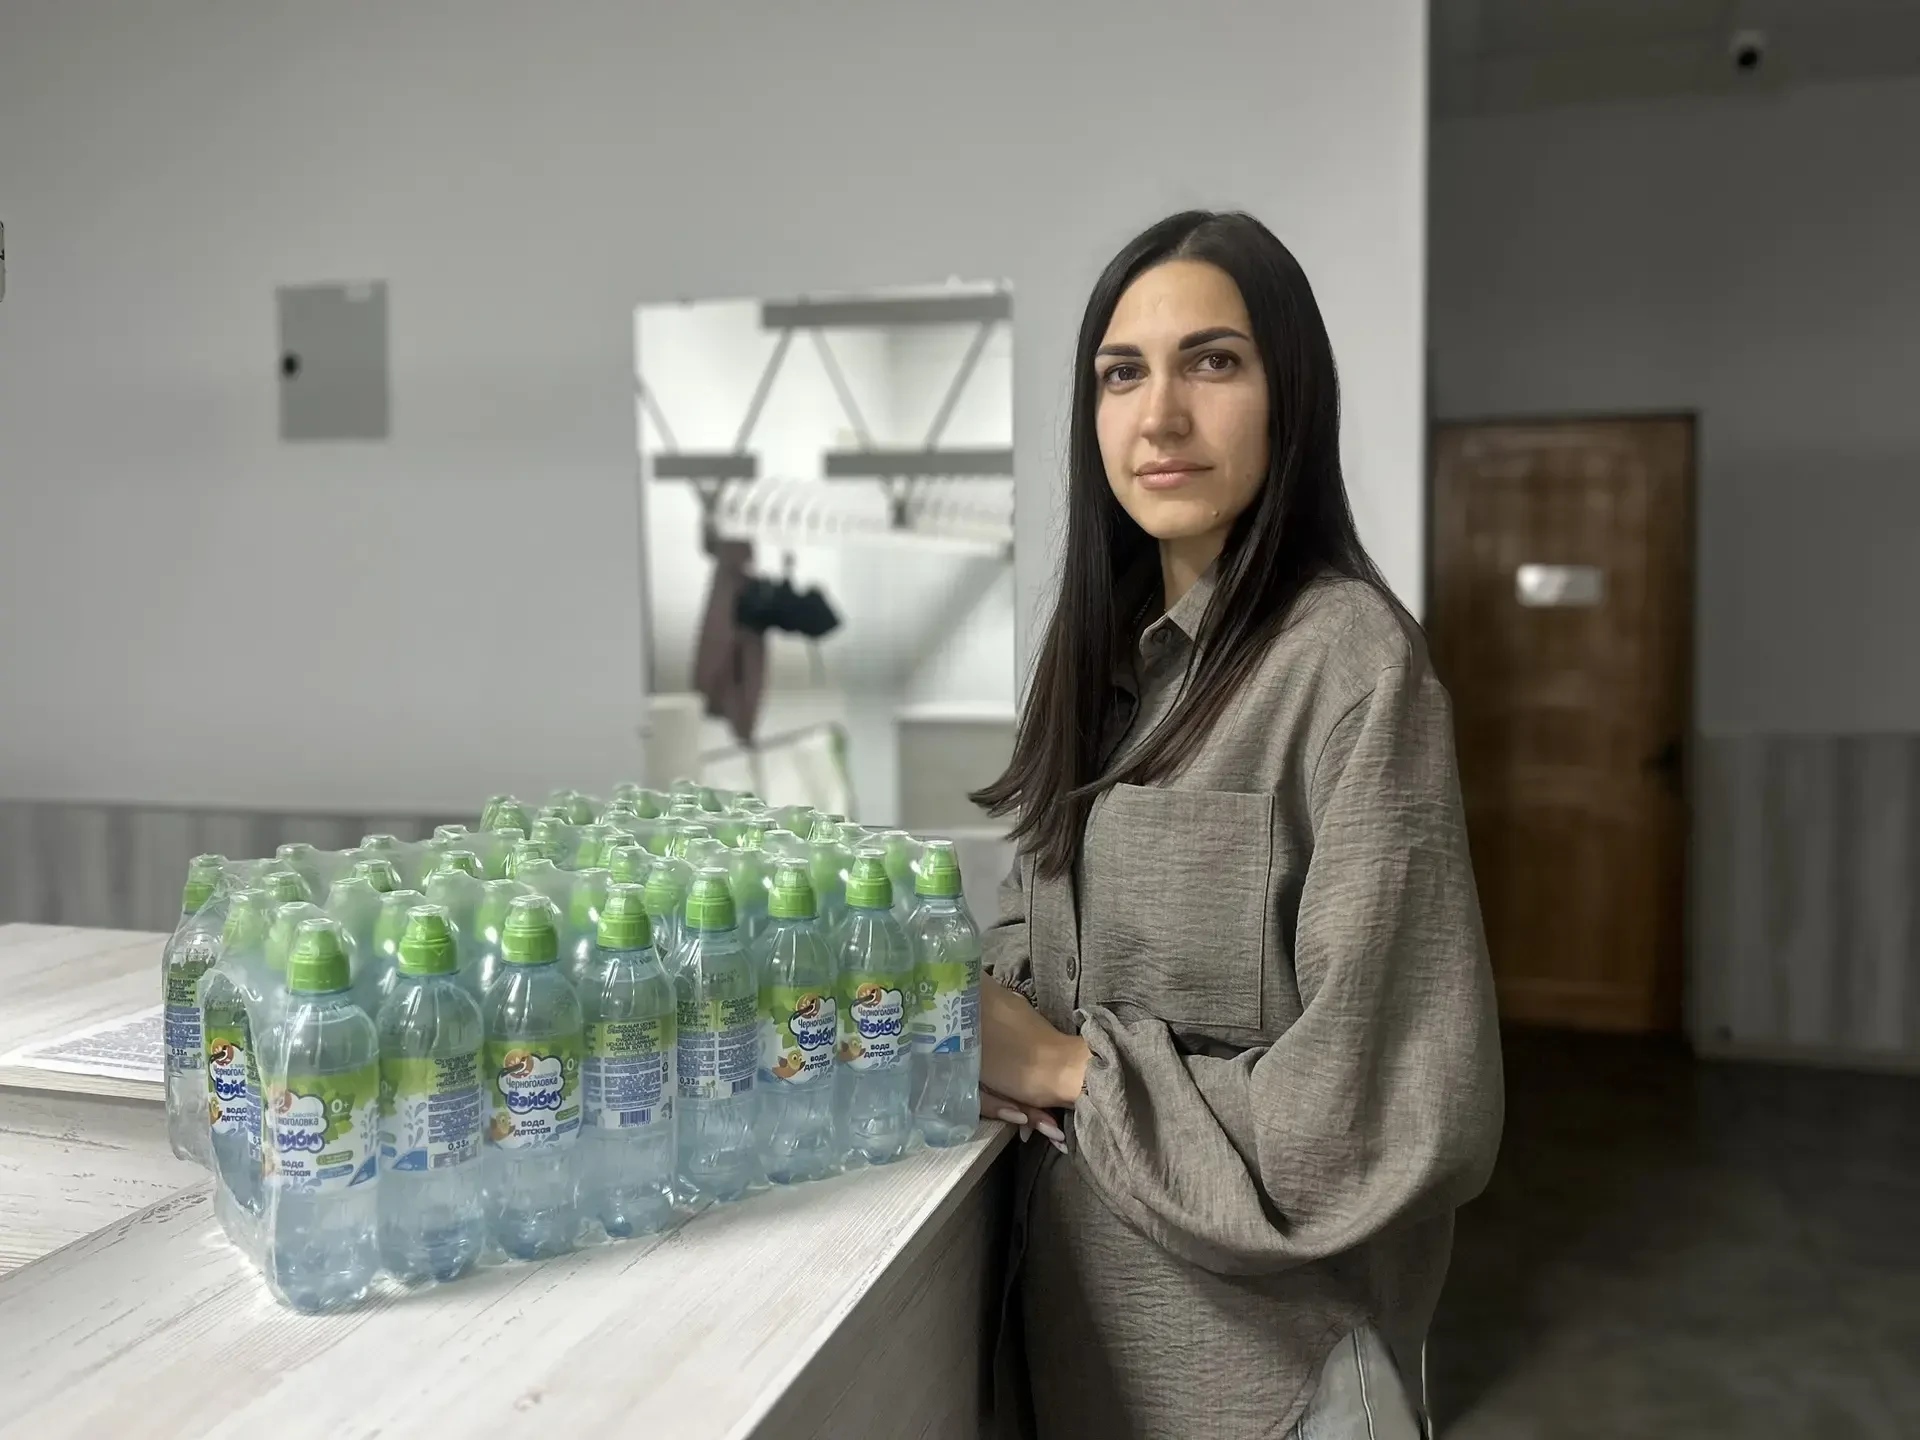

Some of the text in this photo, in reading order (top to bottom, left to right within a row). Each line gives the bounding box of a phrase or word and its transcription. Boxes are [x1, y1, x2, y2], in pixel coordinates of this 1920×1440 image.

[861, 1017, 900, 1033] Бэйби
[870, 1043, 890, 1051] вода
[810, 1053, 827, 1062] вода
[863, 1049, 895, 1059] детская
[506, 1077, 558, 1092] Черноголовка
[507, 1088, 558, 1108] Бэйби
[331, 1098, 350, 1113] 0+
[521, 1119, 545, 1128] вода
[513, 1126, 551, 1137] детская
[281, 1160, 304, 1168] вода
